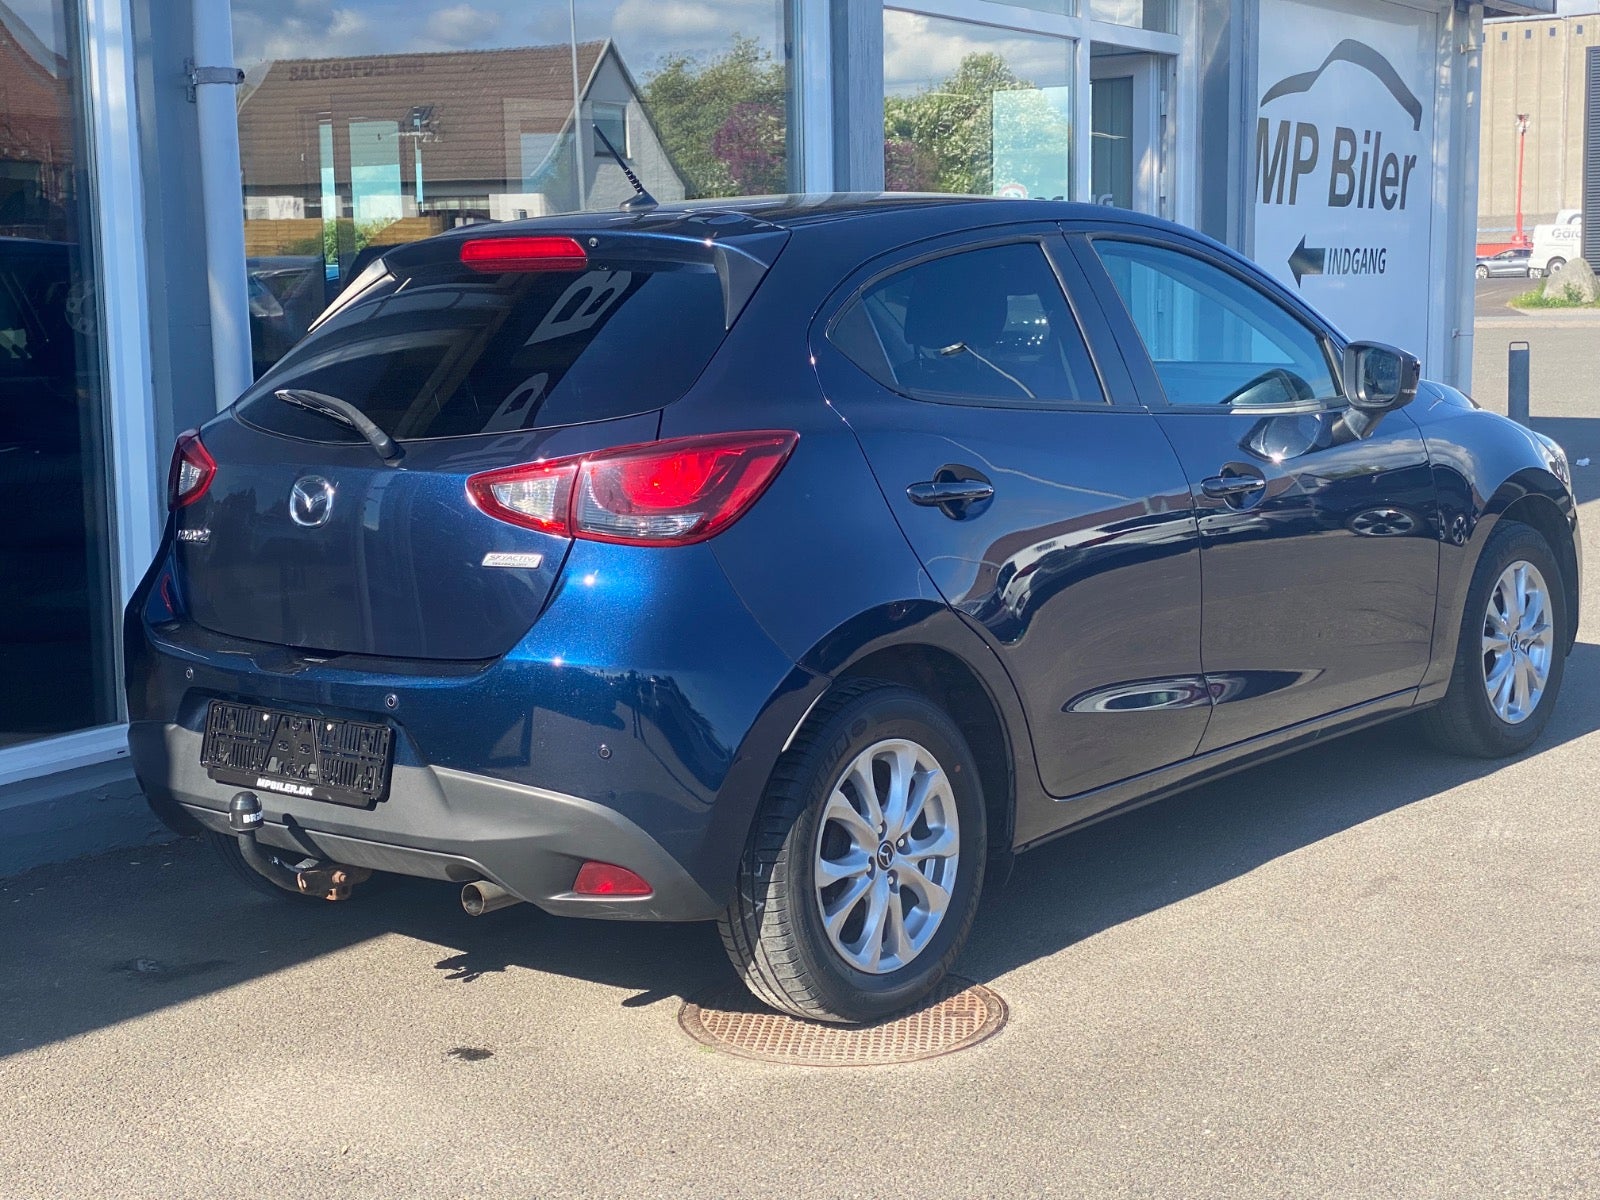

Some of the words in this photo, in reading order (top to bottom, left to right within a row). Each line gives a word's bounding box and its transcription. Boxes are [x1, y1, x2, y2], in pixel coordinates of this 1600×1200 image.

[1256, 117, 1320, 206] MP
[1327, 126, 1418, 211] Biler
[1327, 247, 1387, 275] INDGANG
[256, 777, 315, 796] MPBILER.DK
